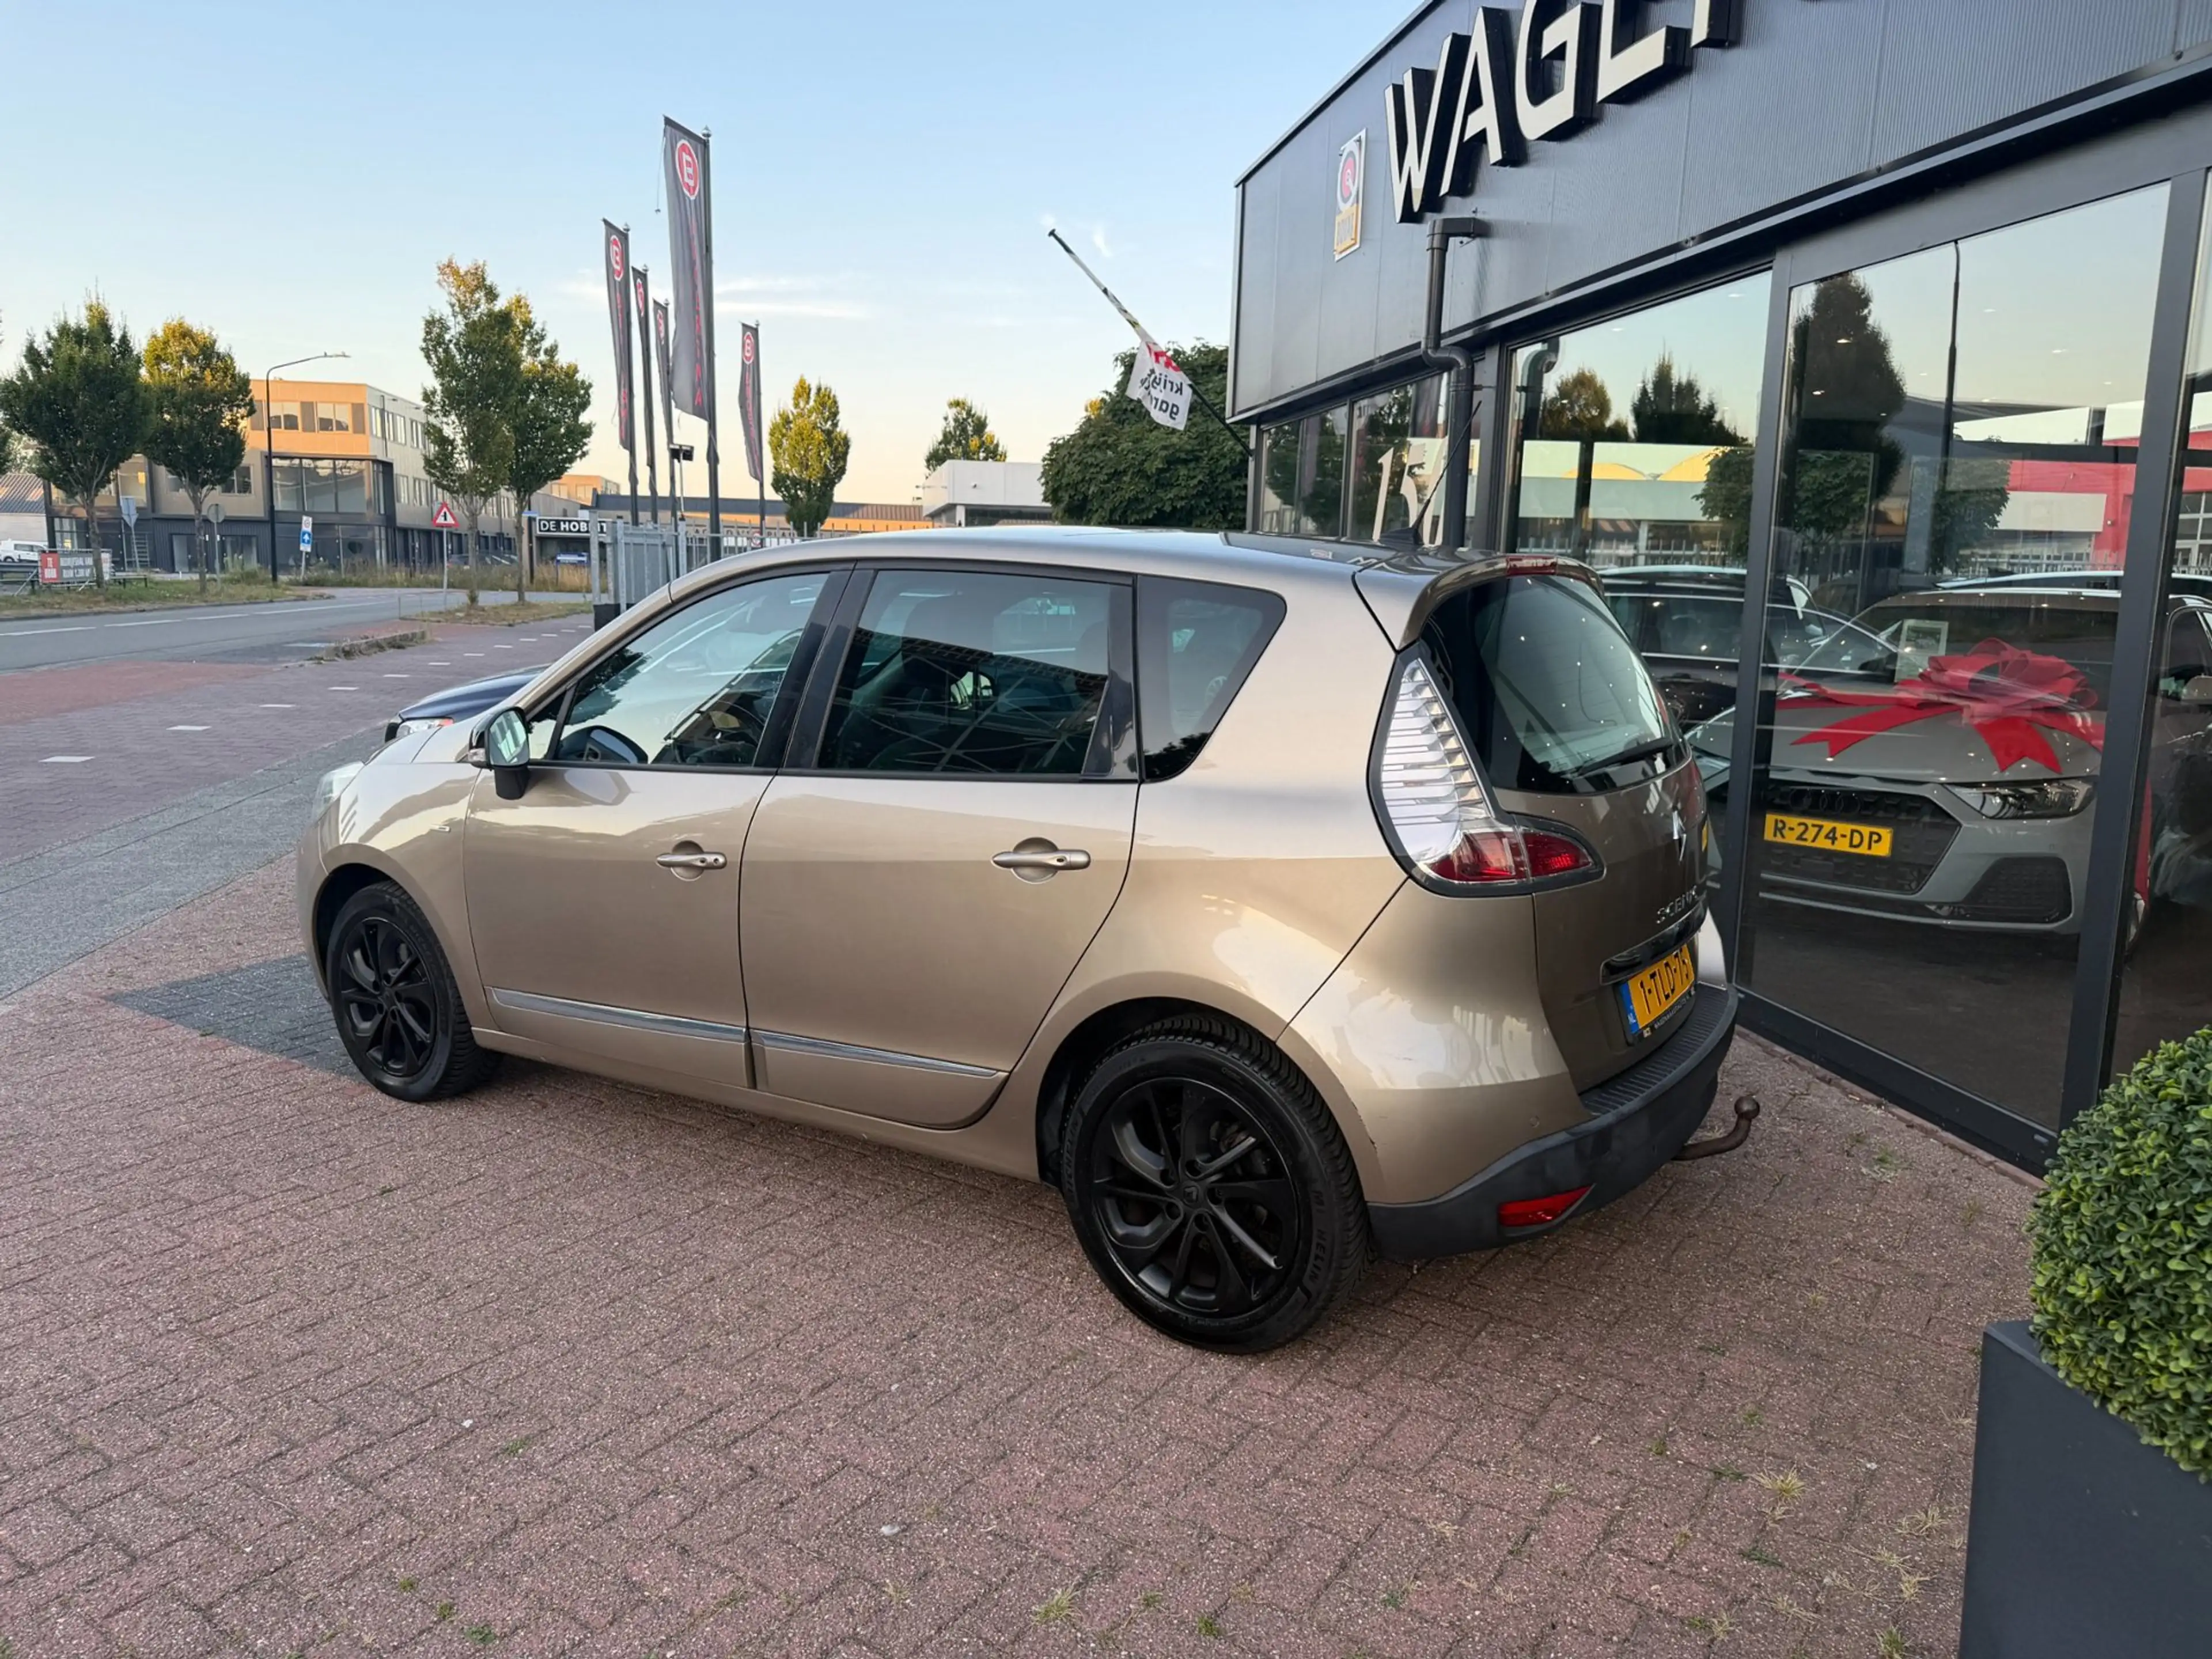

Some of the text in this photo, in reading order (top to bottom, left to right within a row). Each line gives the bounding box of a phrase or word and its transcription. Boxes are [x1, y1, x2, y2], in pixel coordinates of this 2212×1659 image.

[540, 521, 607, 532] DE HOBIT
[1773, 818, 1883, 851] R-274-DP
[1639, 948, 1689, 1015] 1-TLD-75
[1309, 1190, 1327, 1283] MIHELIN
